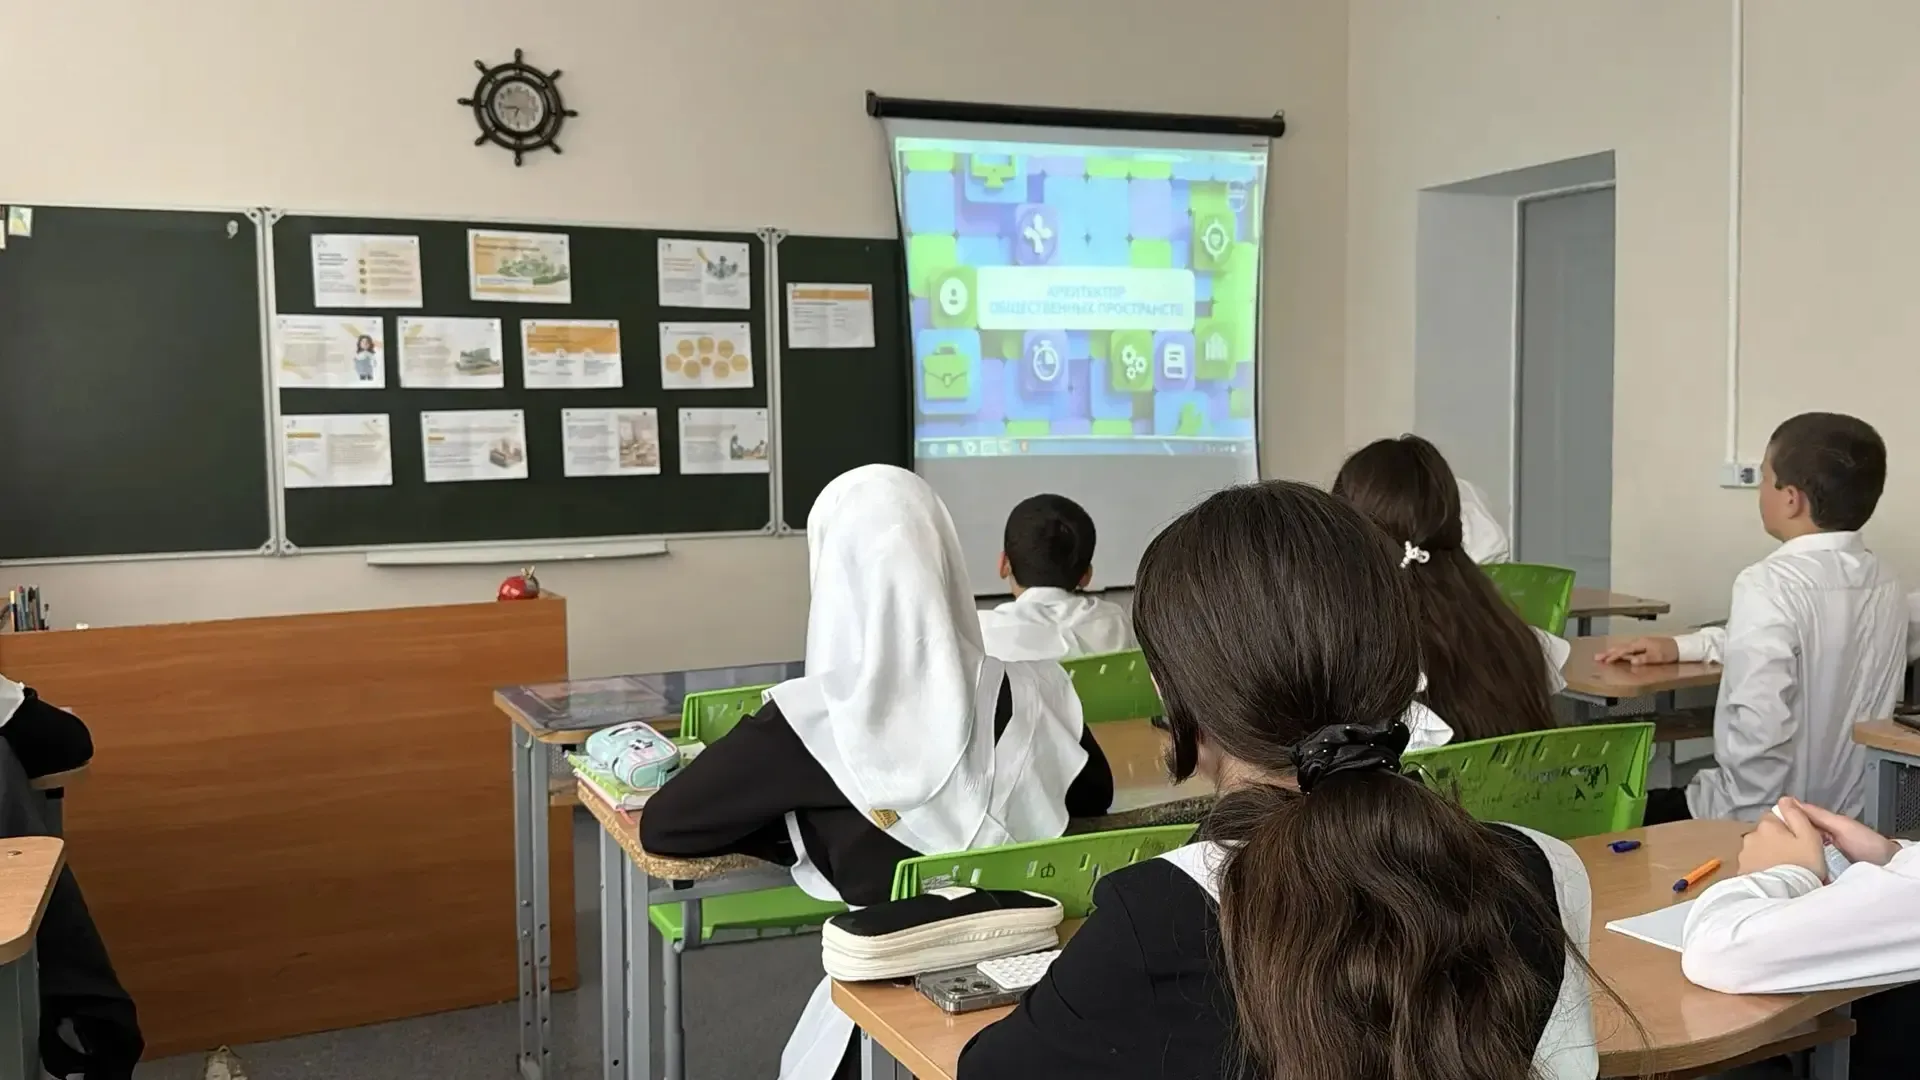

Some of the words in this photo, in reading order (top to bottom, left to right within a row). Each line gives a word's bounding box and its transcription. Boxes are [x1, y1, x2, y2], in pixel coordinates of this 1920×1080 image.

[1047, 285, 1127, 298] АРХИТЕКТОР
[991, 300, 1095, 314] ОБЩЕСТВЕННЫХ
[1097, 302, 1184, 316] ПРОСТРАНСТВ
